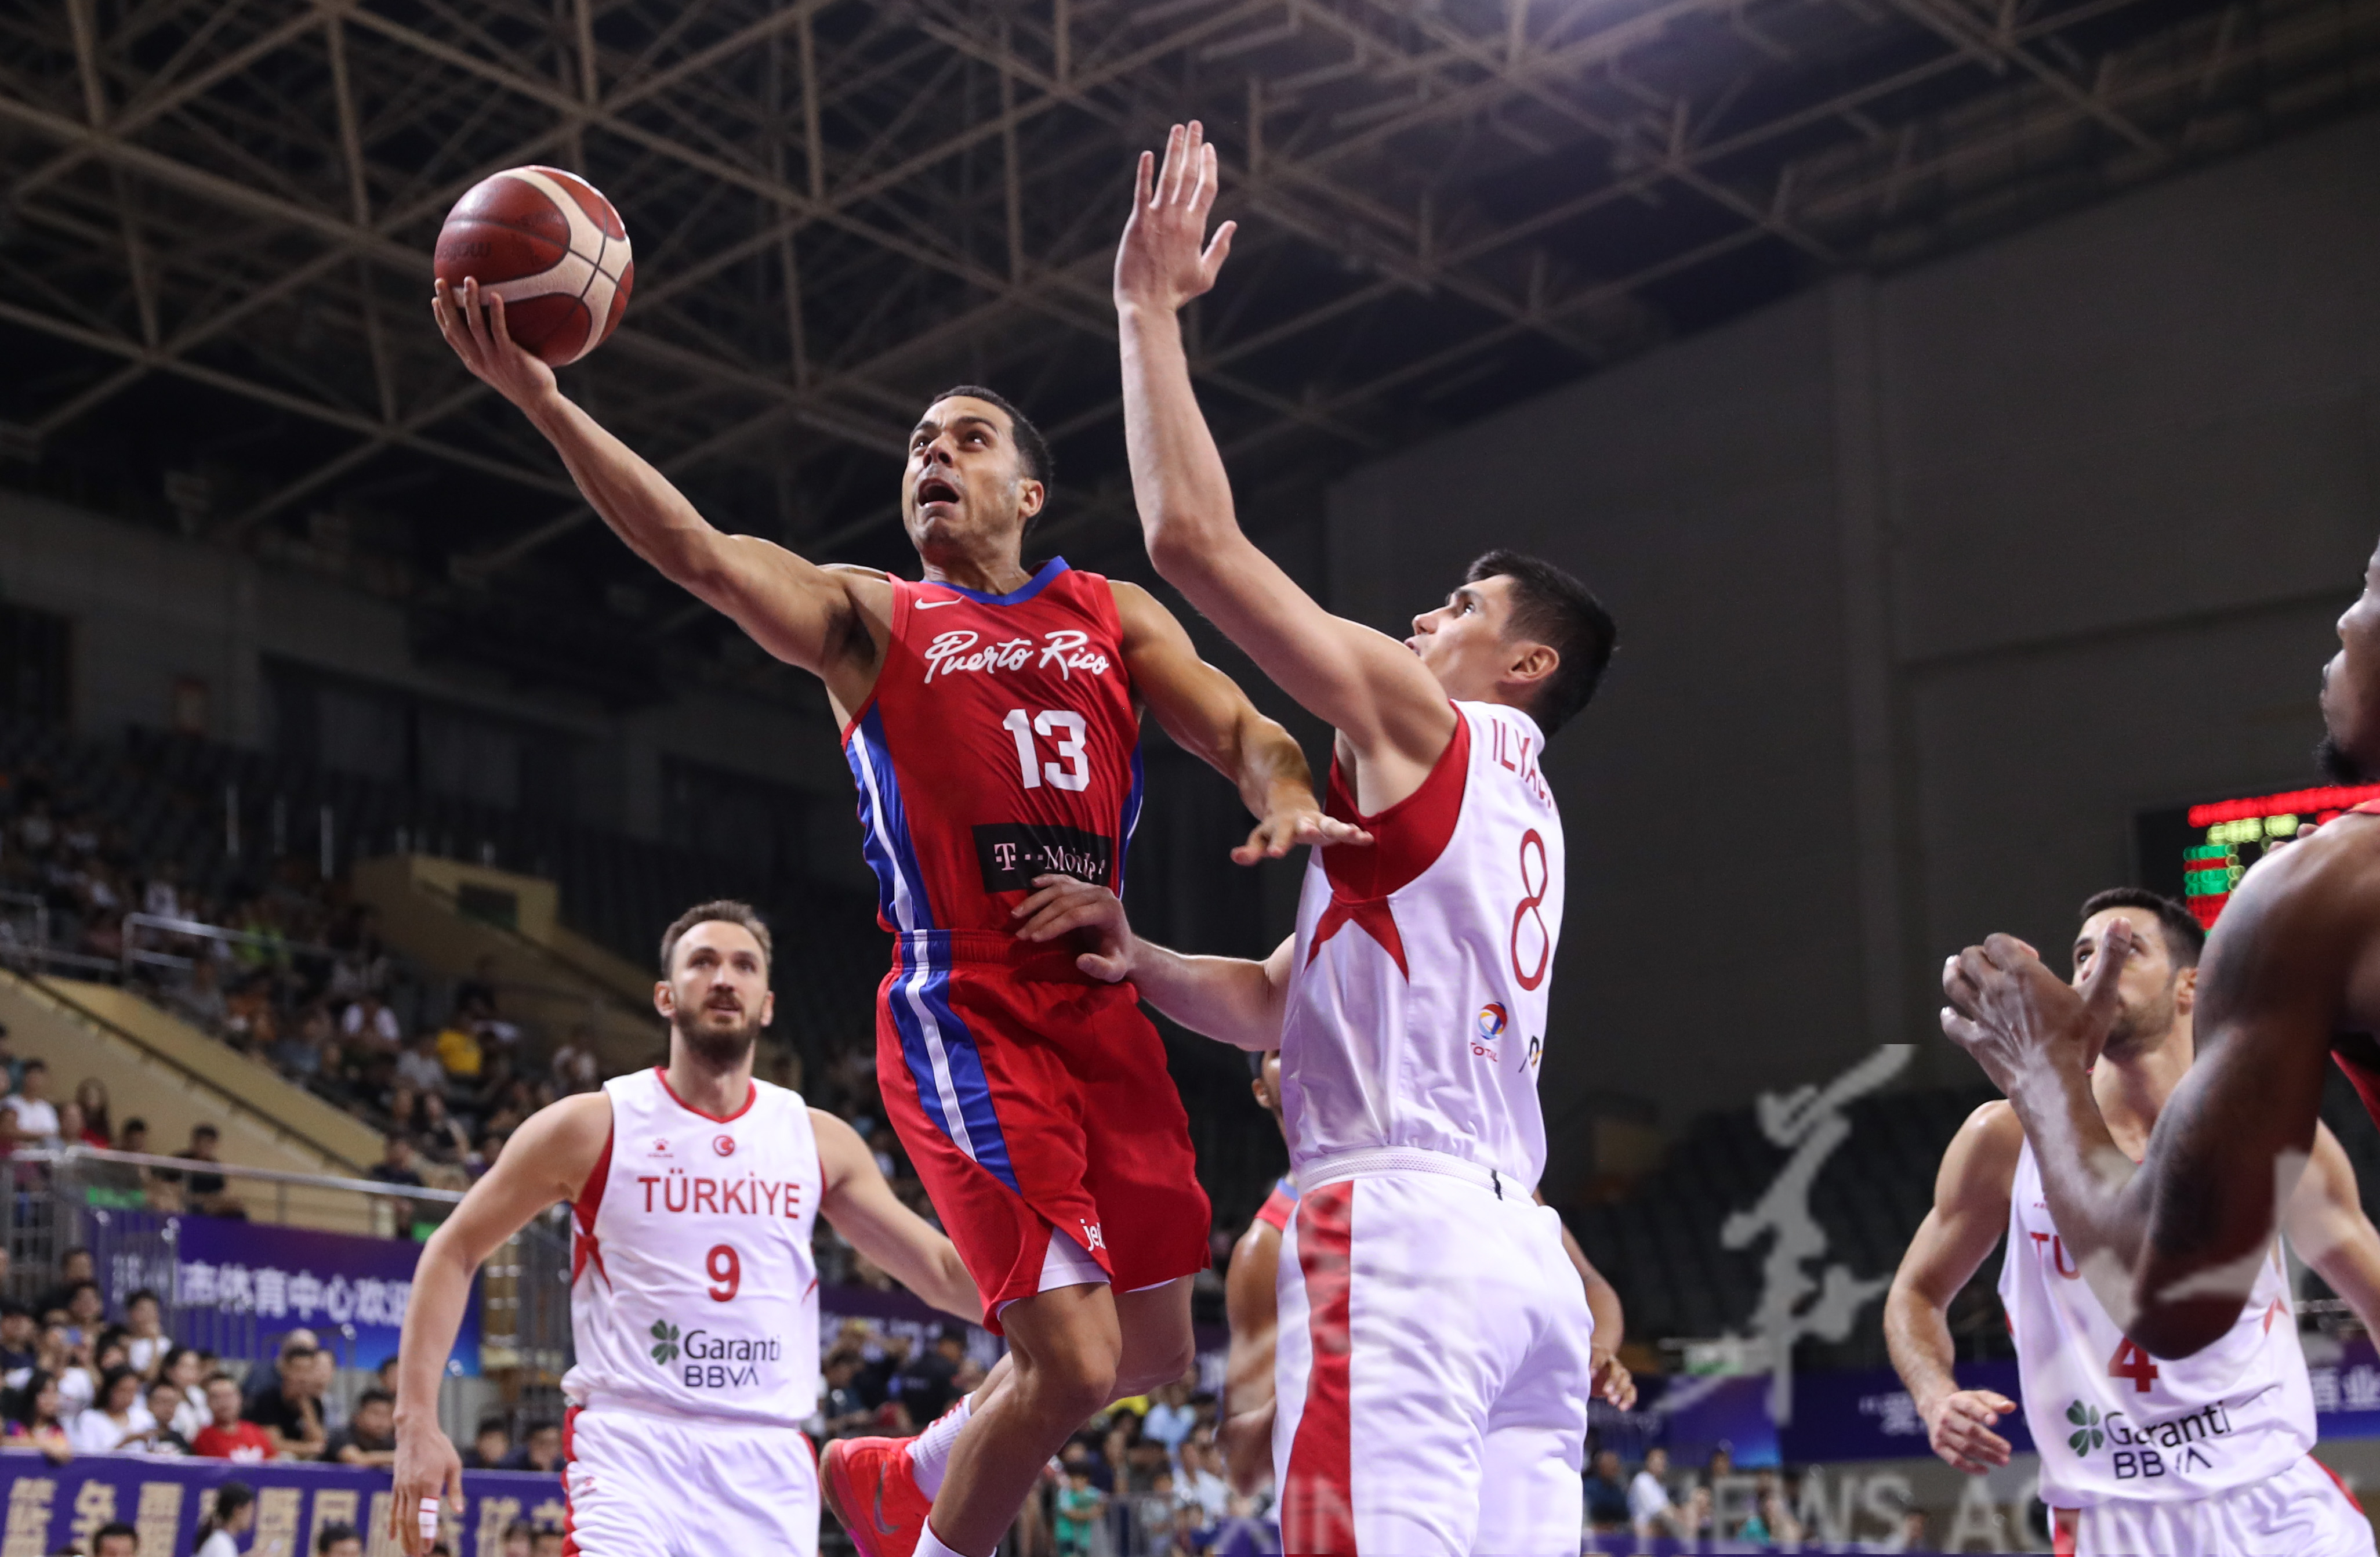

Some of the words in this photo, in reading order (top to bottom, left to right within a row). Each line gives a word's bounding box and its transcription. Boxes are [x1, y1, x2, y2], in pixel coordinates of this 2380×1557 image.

[925, 631, 1033, 683] Puerto
[1039, 630, 1108, 680] Rico
[1003, 709, 1090, 791] 13
[1512, 828, 1549, 990] 8
[1470, 1042, 1498, 1062] TOTAL
[638, 1168, 801, 1219] TÜRKİYE
[706, 1244, 741, 1302] 9
[684, 1330, 781, 1361] Garanti
[2108, 1336, 2158, 1392] 4
[684, 1366, 759, 1388] BBVA
[2105, 1400, 2232, 1447] Garanti
